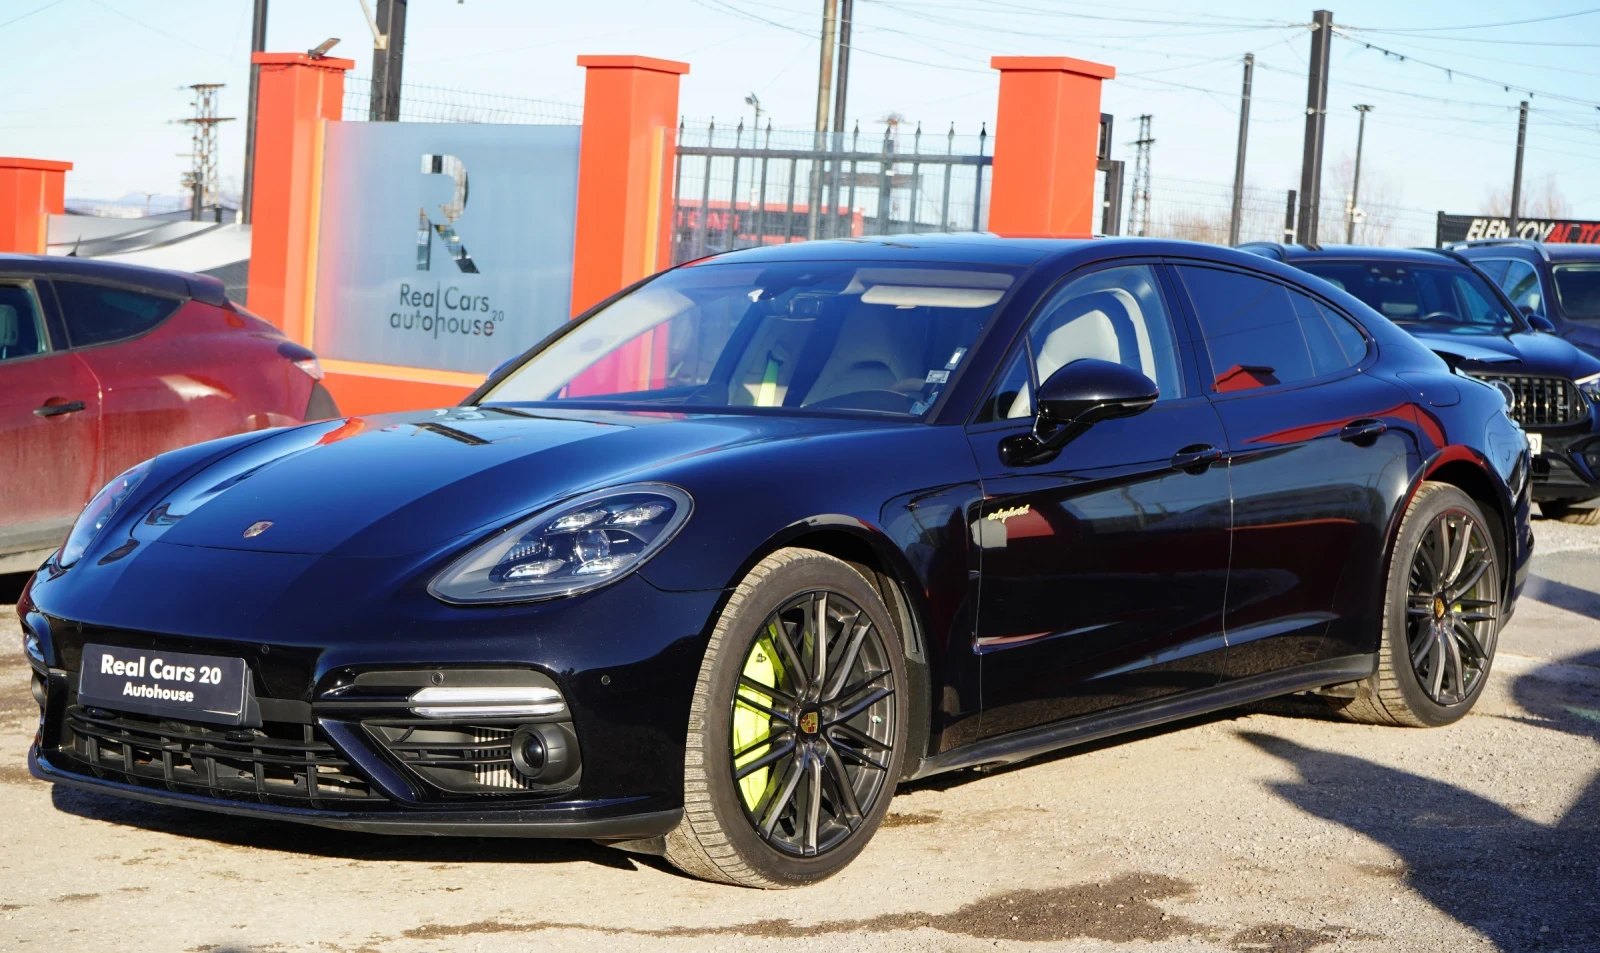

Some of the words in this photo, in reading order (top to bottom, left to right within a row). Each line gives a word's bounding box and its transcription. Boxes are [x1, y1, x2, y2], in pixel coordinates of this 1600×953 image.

[1466, 218, 1556, 242] ELENOV
[400, 281, 441, 308] Real
[444, 286, 489, 313] Cars
[390, 309, 495, 338] autohouse
[101, 654, 146, 678] Real
[150, 658, 195, 683] Cars
[199, 666, 222, 685] 20
[123, 681, 194, 702] Autohouse
